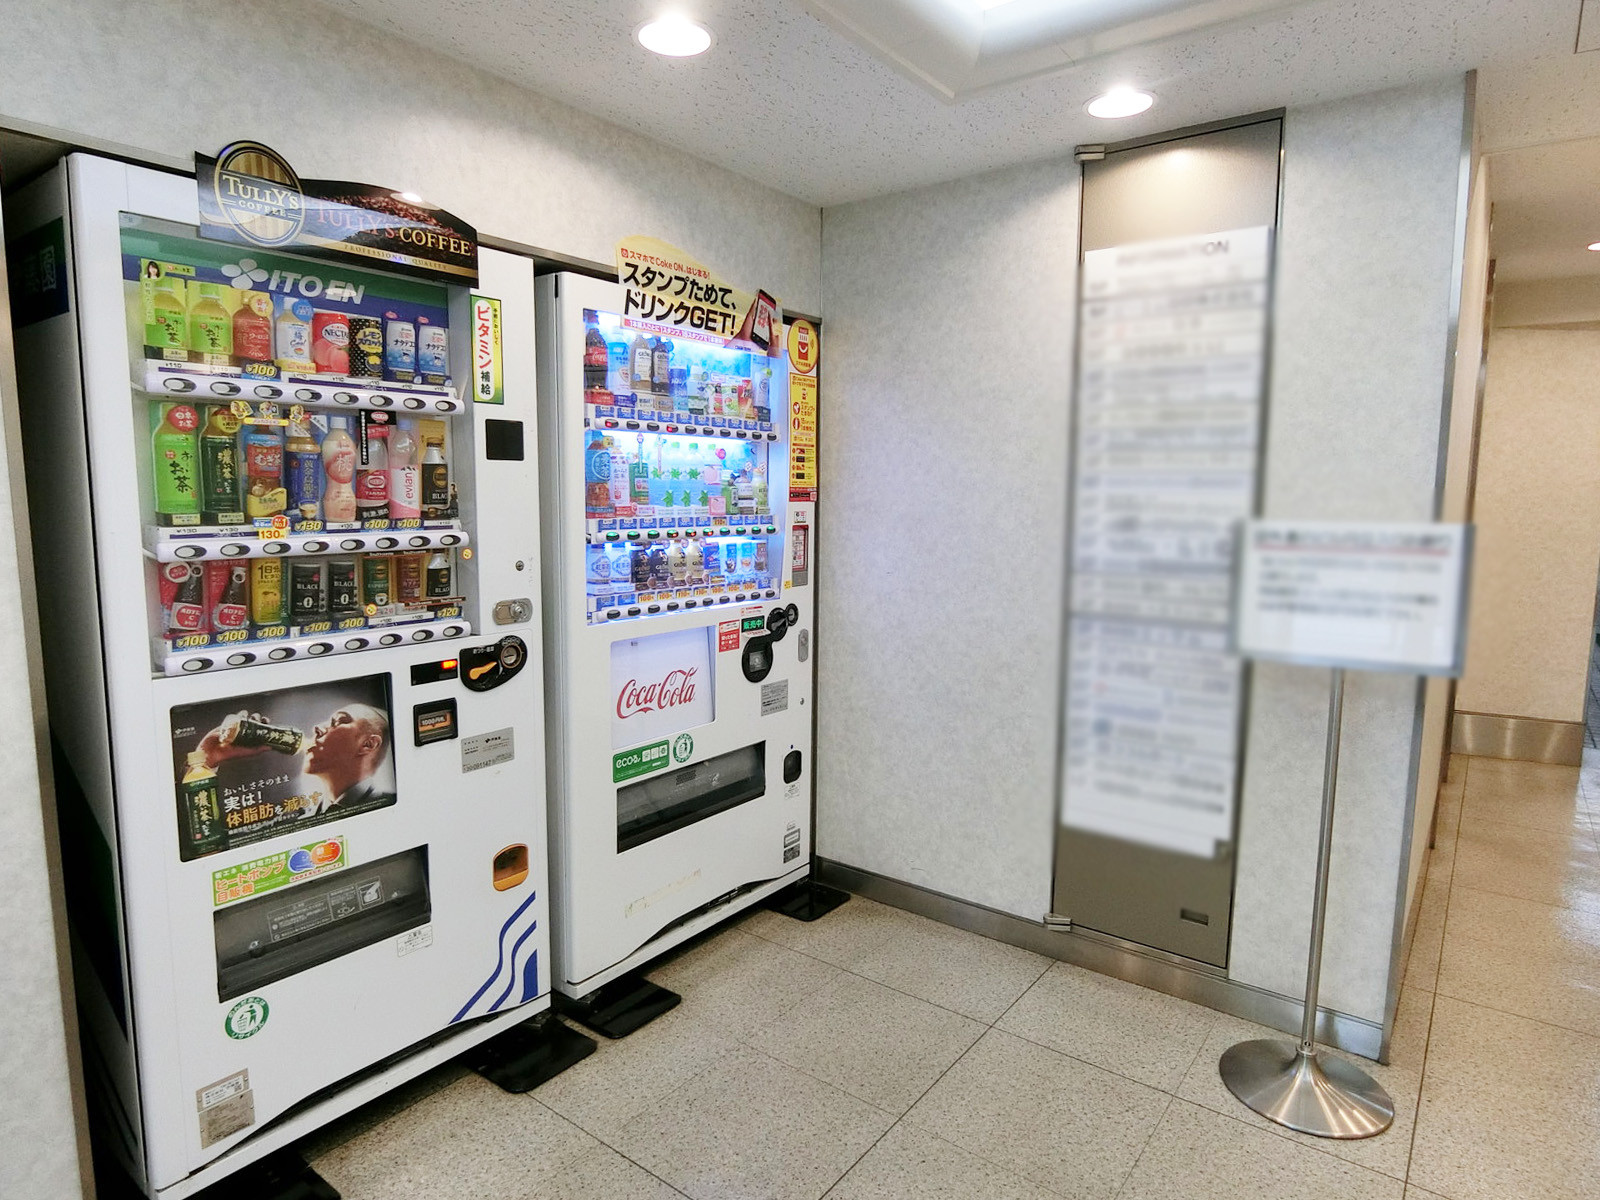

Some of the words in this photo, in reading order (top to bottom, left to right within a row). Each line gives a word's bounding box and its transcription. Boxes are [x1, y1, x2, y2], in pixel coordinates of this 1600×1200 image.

[222, 174, 299, 210] TULLY'S
[316, 199, 395, 239] TULLY'S
[399, 227, 472, 257] COFFEE
[622, 261, 737, 310] スタンプためて、
[623, 288, 736, 336] ドリンクGET!
[405, 471, 415, 500] evian
[616, 666, 699, 720] Coca-Cola
[223, 774, 290, 797] おいしさそのまま
[223, 790, 263, 813] 実は!
[225, 790, 323, 829] 体脂肪を減らす
[215, 858, 287, 892] ヒートポンプ
